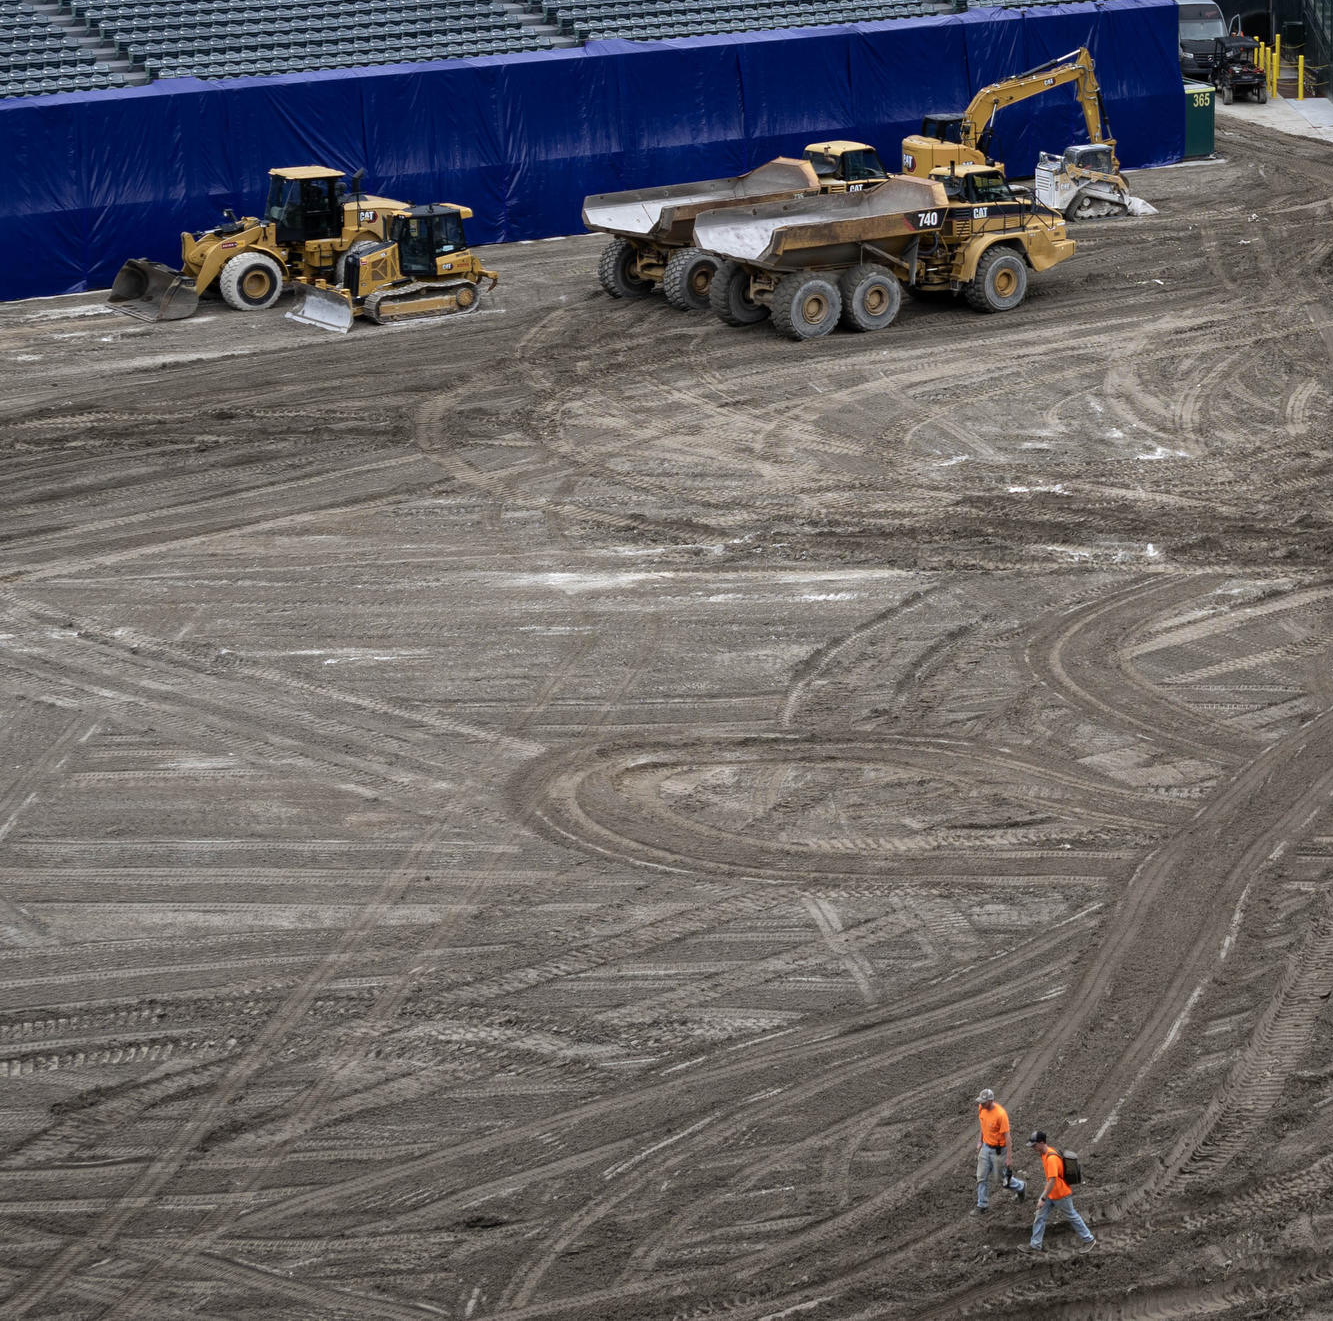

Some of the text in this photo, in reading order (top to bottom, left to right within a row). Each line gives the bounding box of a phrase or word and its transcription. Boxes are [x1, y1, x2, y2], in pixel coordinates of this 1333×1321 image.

[1193, 94, 1210, 107] 365
[360, 212, 374, 222] CAT
[973, 207, 988, 219] CAT
[918, 212, 938, 227] 740
